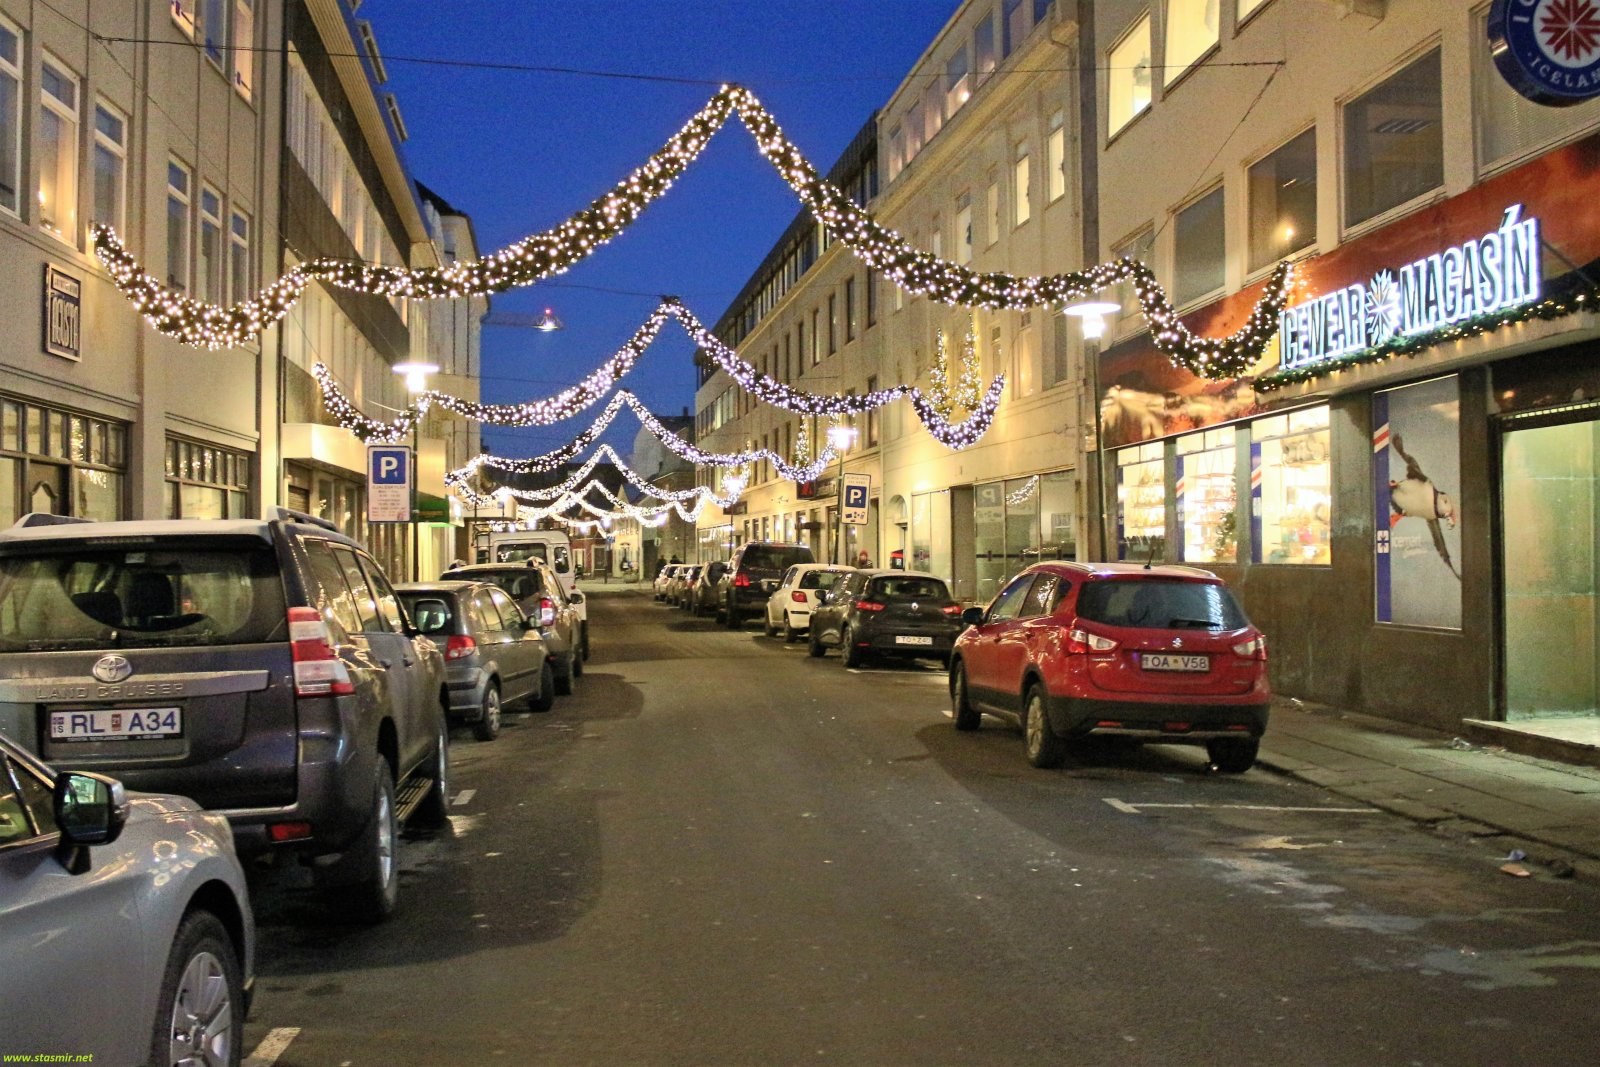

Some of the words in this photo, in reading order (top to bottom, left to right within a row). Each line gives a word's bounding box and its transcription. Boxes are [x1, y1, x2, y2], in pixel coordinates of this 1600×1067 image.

[1278, 283, 1368, 370] ICEWEAR
[1400, 203, 1541, 337] MAGASÍN
[380, 456, 398, 479] P
[849, 488, 862, 504] P
[1151, 656, 1170, 667] OA
[1181, 657, 1207, 669] V58
[36, 687, 89, 699] LAND
[97, 683, 184, 698] CRUISER
[71, 714, 105, 734] RL
[128, 711, 176, 731] A34
